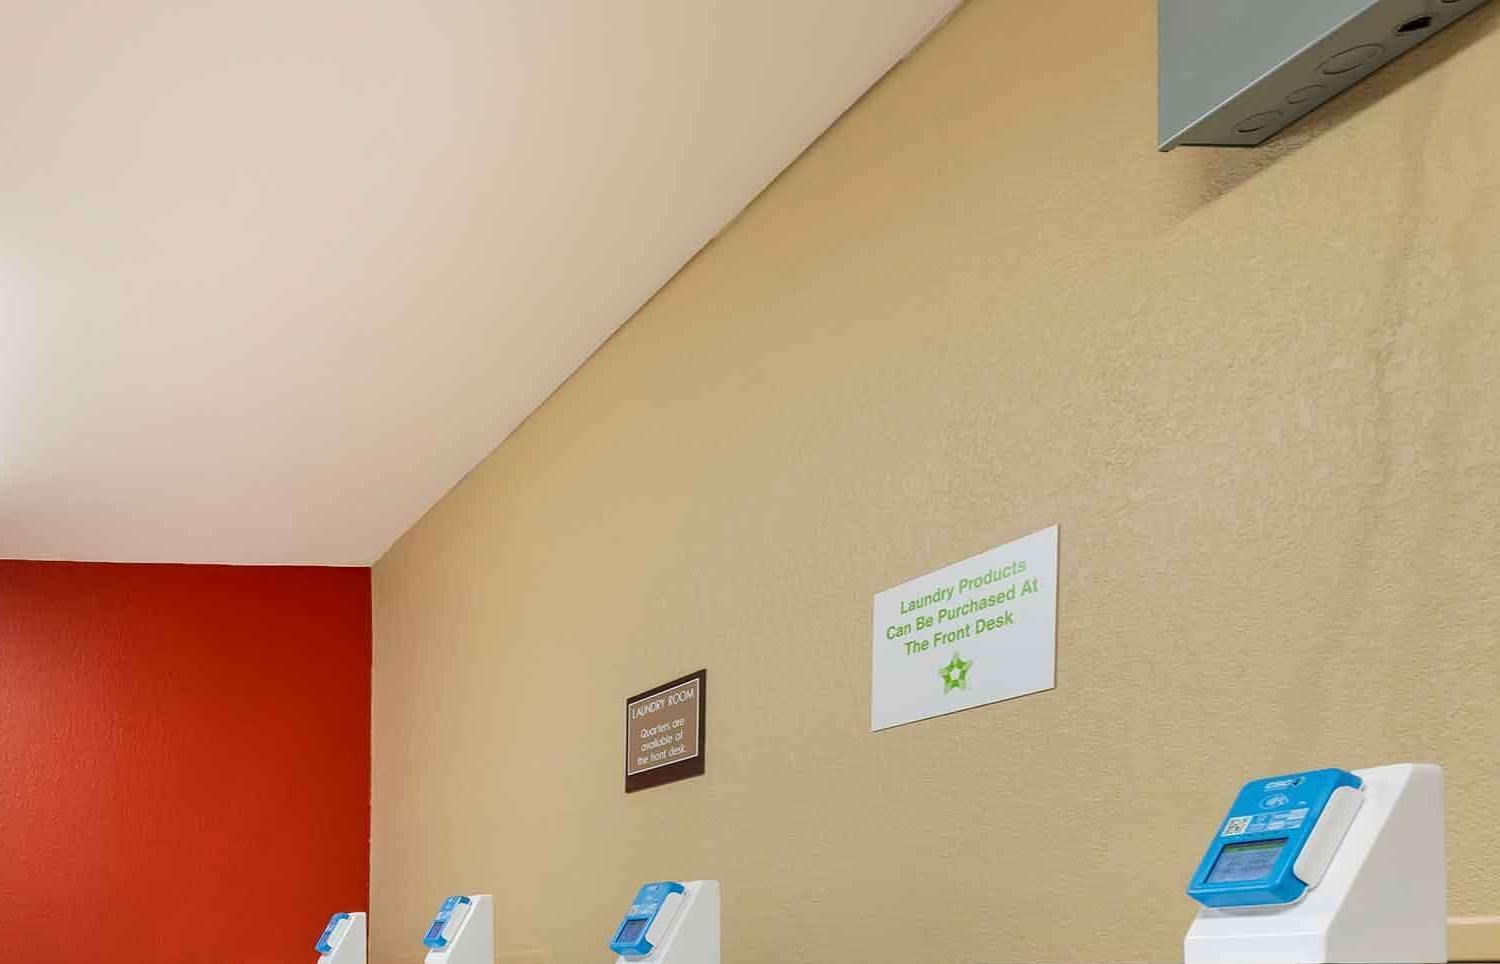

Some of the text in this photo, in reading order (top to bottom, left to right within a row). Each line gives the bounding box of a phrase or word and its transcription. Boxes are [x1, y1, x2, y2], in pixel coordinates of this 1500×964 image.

[886, 578, 1039, 640] Can Be Purchased At
[900, 560, 1027, 615] Laundry Products
[905, 611, 1013, 656] The Front Desk
[632, 688, 694, 719] LAUNDRY ROOM
[672, 718, 685, 728] are
